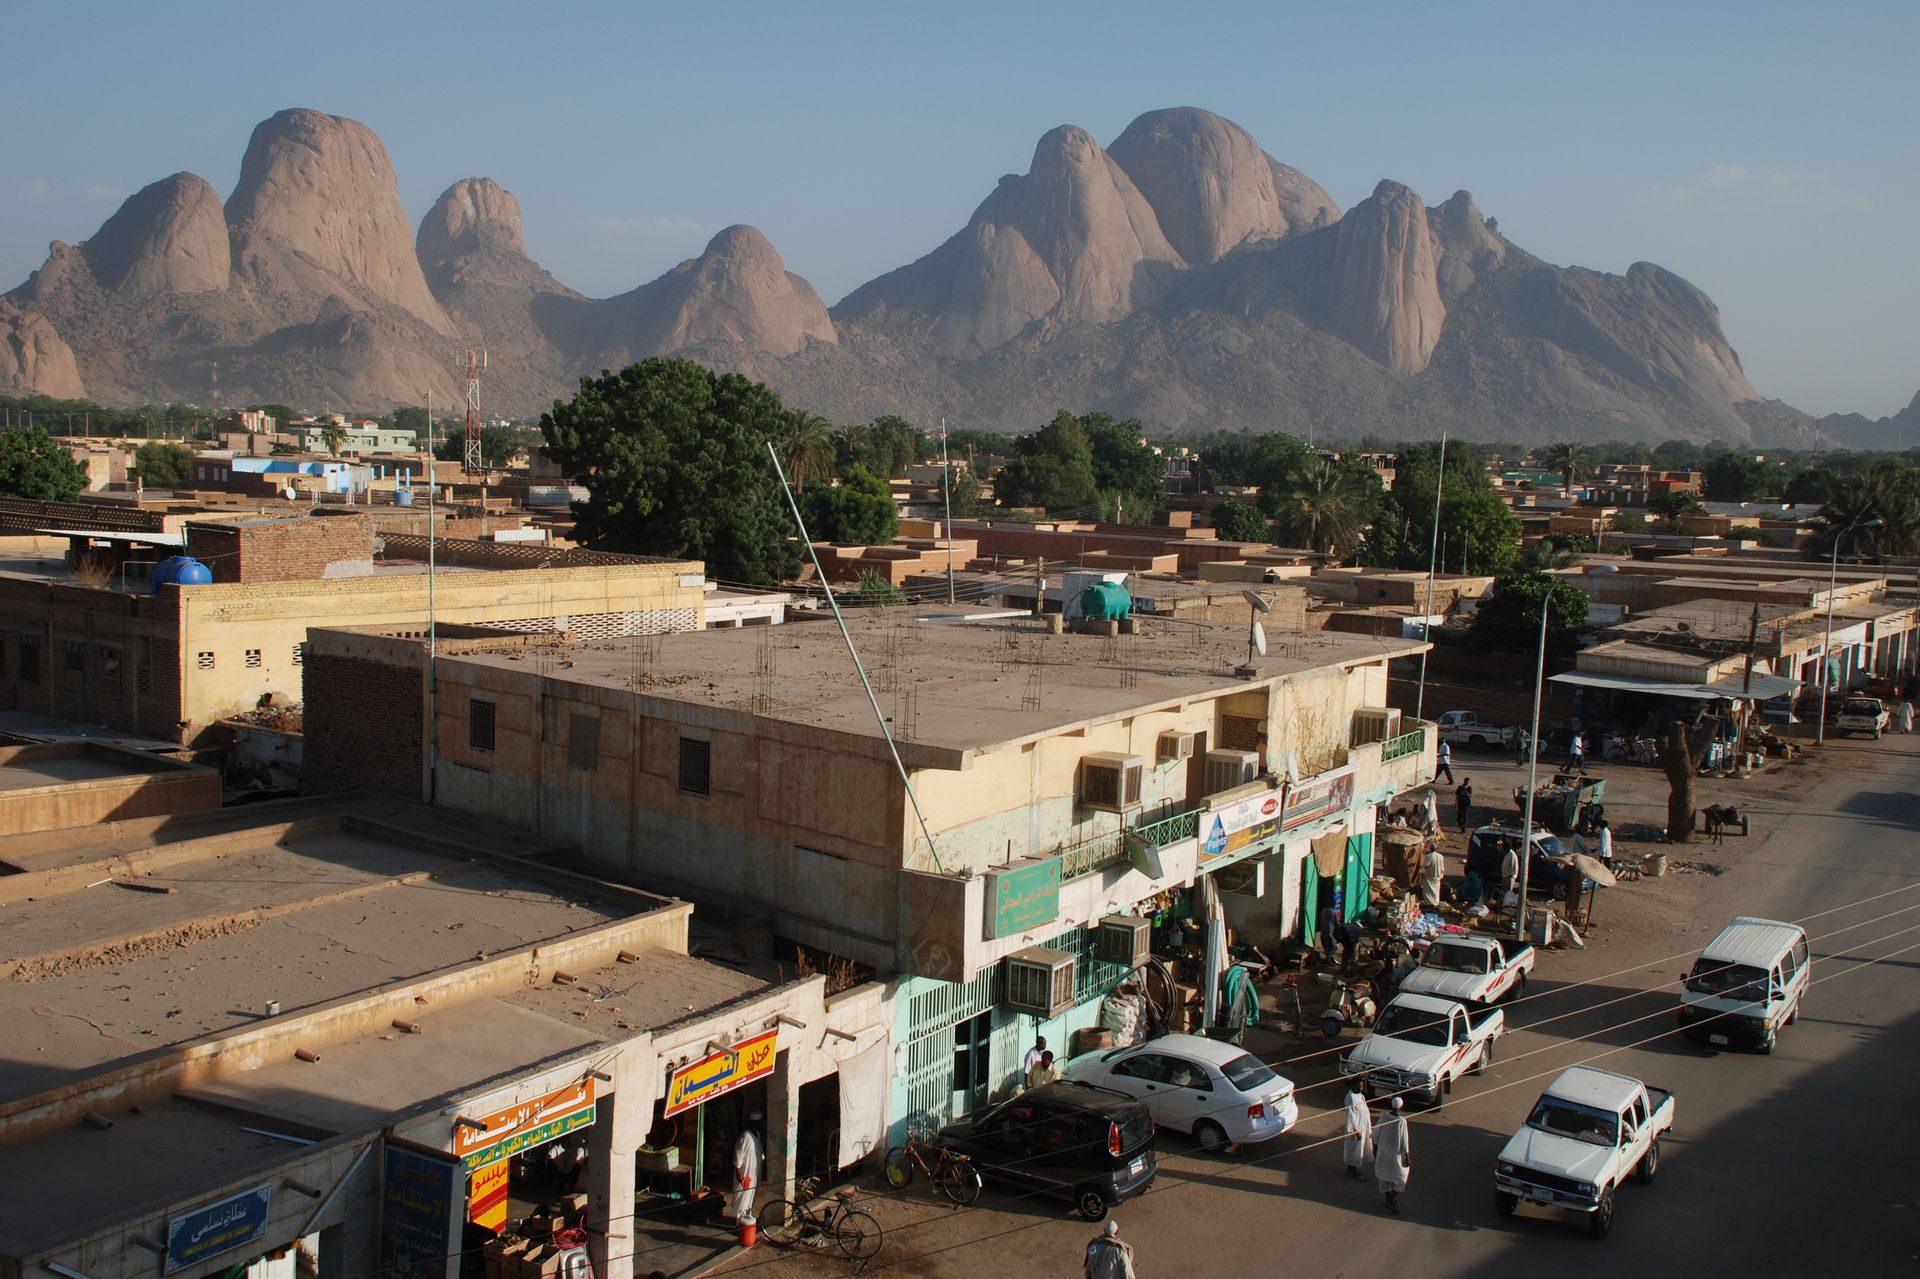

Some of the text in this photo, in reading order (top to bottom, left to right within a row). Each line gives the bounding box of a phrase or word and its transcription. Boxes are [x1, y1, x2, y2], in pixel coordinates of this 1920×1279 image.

[1211, 827, 1224, 836] Nile
[1207, 836, 1228, 850] Paints
[566, 1110, 591, 1130] لمواد
